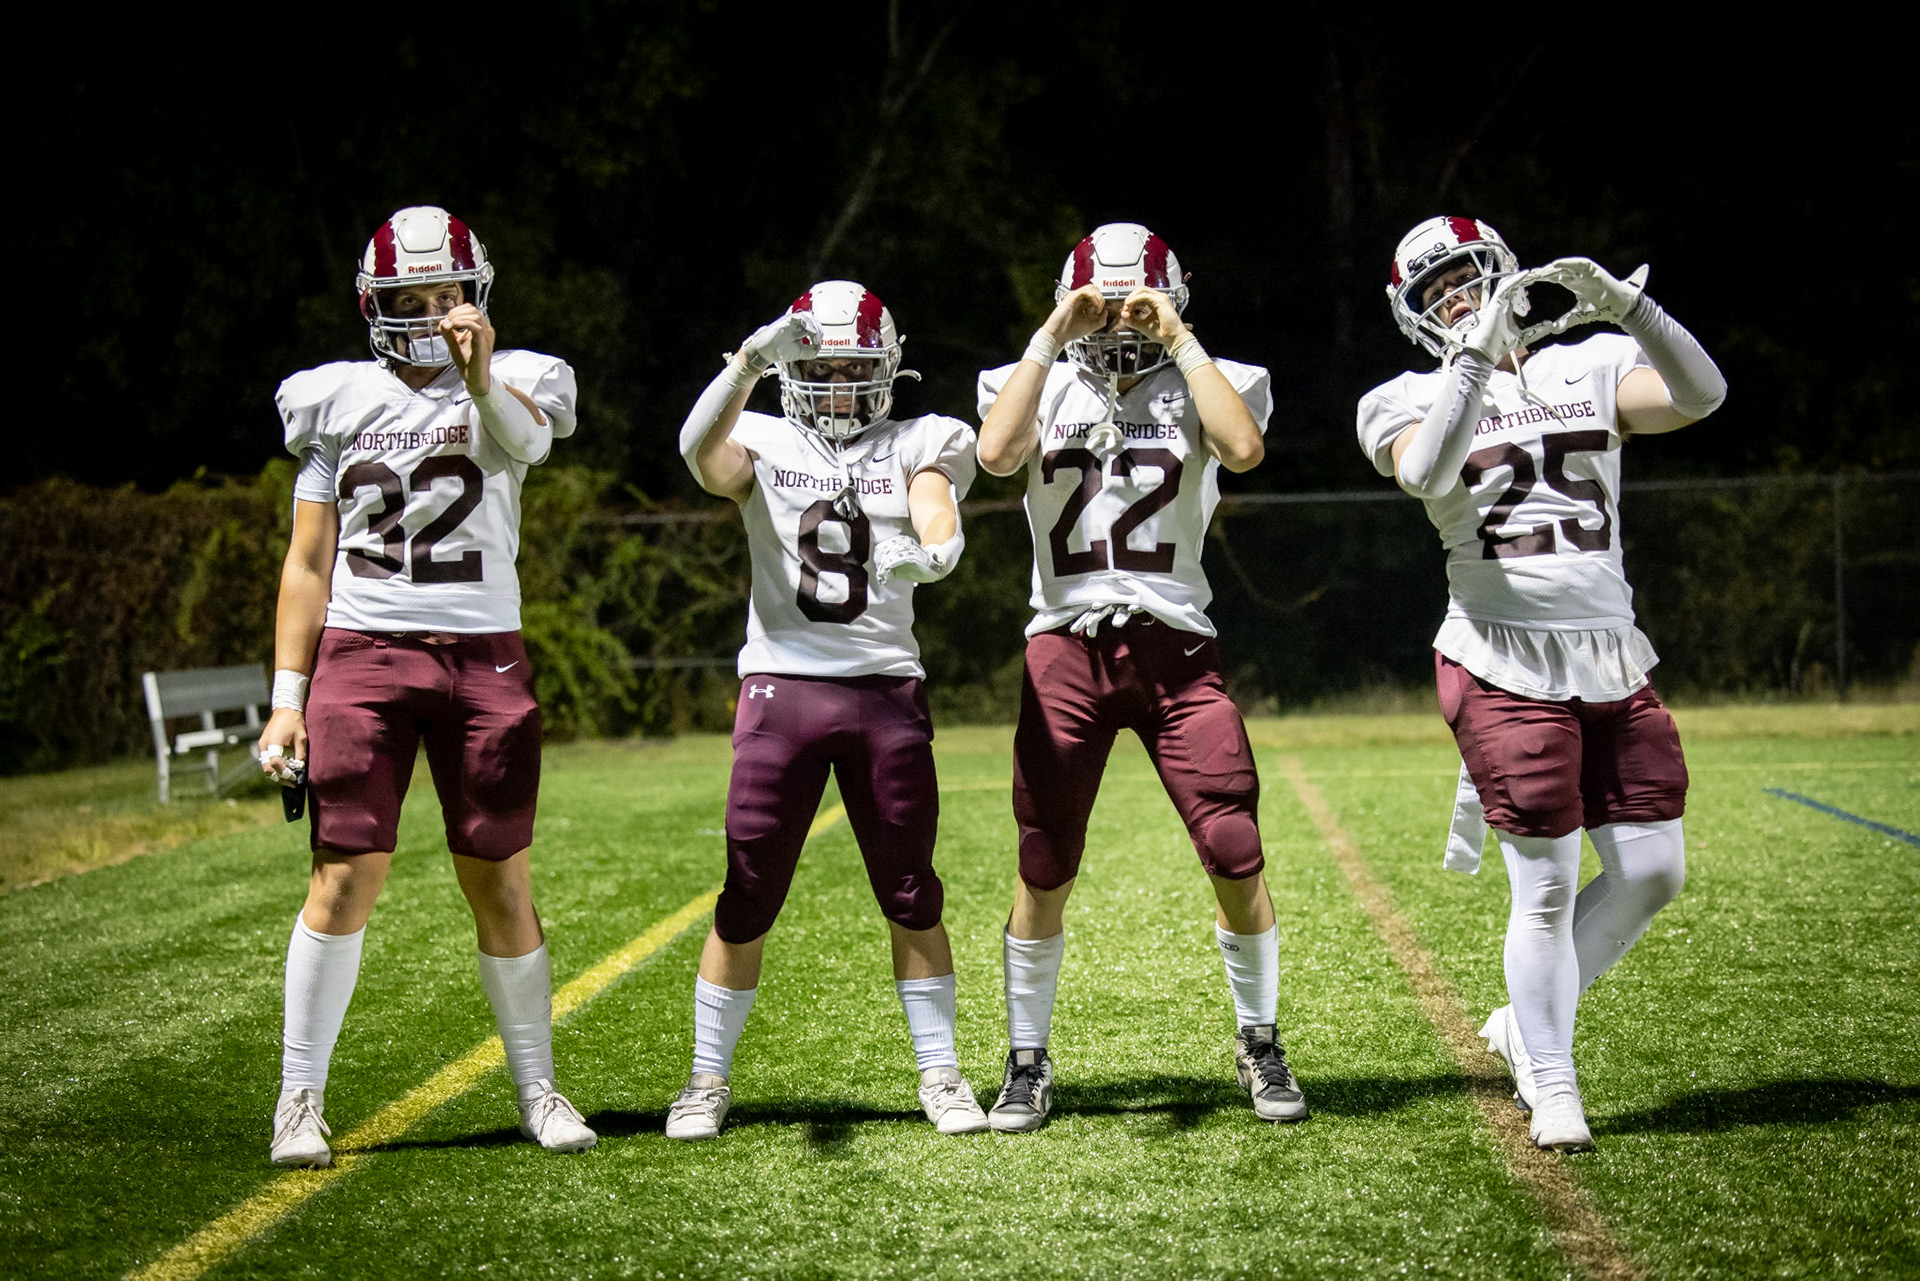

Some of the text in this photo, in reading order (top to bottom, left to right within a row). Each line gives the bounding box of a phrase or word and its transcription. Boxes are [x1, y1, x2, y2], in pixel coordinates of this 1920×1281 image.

[408, 263, 442, 274] Riddell
[1102, 279, 1136, 287] Riddell
[1053, 421, 1179, 440] NORBRIDGE
[1474, 400, 1596, 436] ORTHBRDGE
[352, 425, 469, 450] NORTHBRIDGE
[773, 469, 893, 495] NORTHBIDGE
[1461, 429, 1612, 560] 25
[338, 454, 484, 583] 32
[1041, 448, 1184, 577] 22
[796, 499, 870, 625] 8
